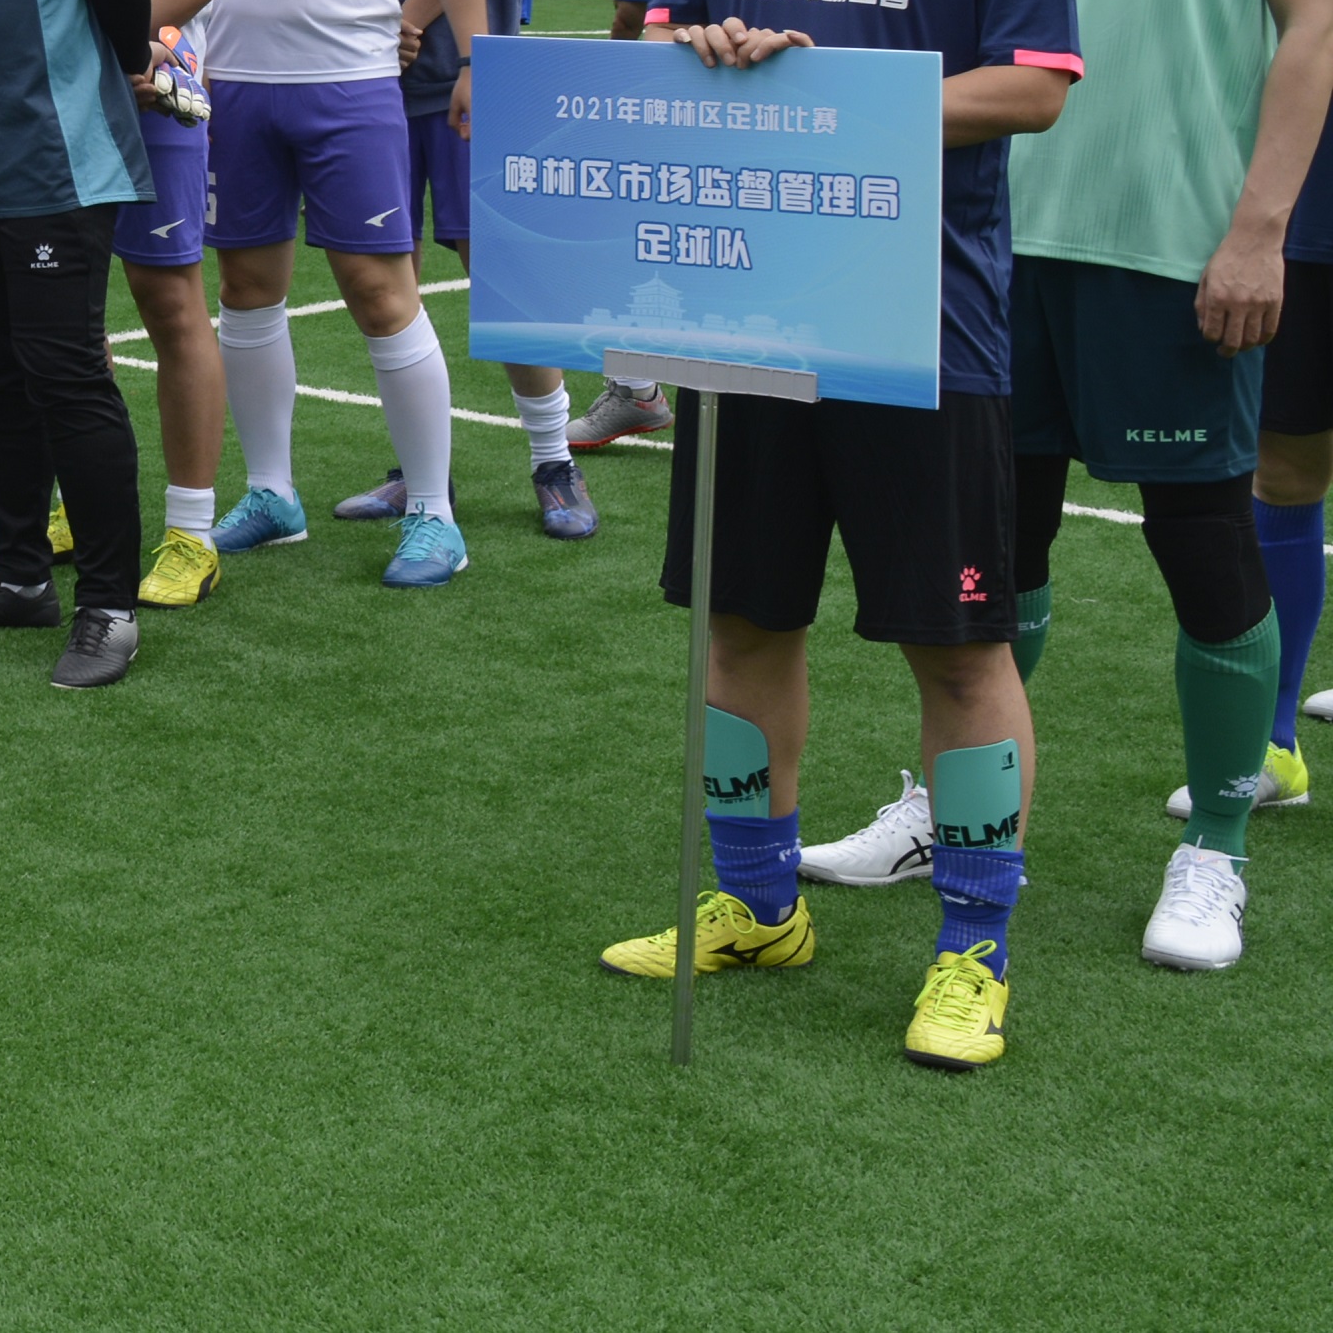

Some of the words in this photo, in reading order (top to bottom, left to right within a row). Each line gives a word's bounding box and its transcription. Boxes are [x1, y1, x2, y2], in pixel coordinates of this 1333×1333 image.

[555, 94, 838, 135] 2021年碑林区足球比赛
[503, 153, 901, 220] 碑林区市场监督管理局
[30, 261, 59, 269] KELME
[635, 221, 754, 270] 足球队
[1126, 429, 1208, 443] KELME
